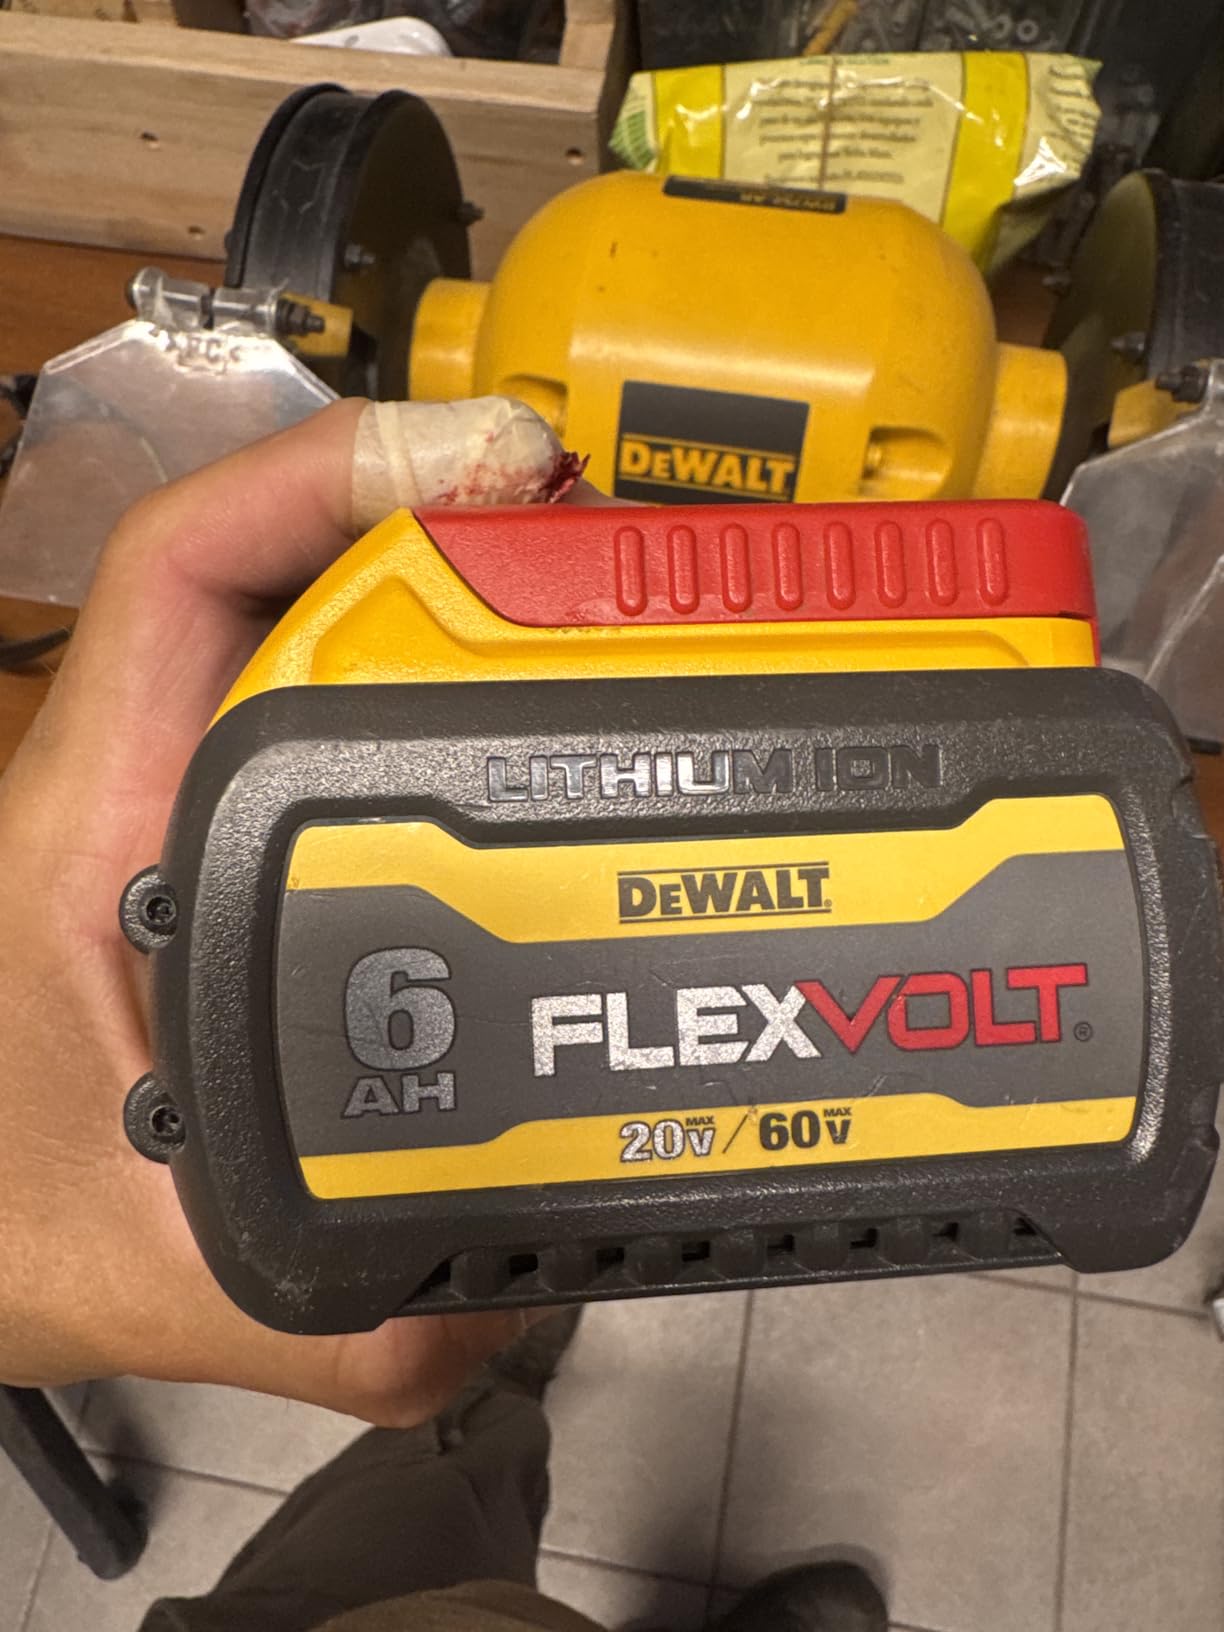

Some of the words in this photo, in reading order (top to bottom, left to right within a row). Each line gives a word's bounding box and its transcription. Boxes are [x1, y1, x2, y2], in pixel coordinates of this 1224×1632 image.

[487, 748, 793, 801] LITHIUM
[815, 744, 941, 792] ION
[344, 946, 456, 1071] 6
[532, 962, 1088, 1078] FLEXVOLT
[341, 1072, 456, 1119] AH
[685, 1115, 716, 1126] MAX
[823, 1107, 852, 1118] MAX
